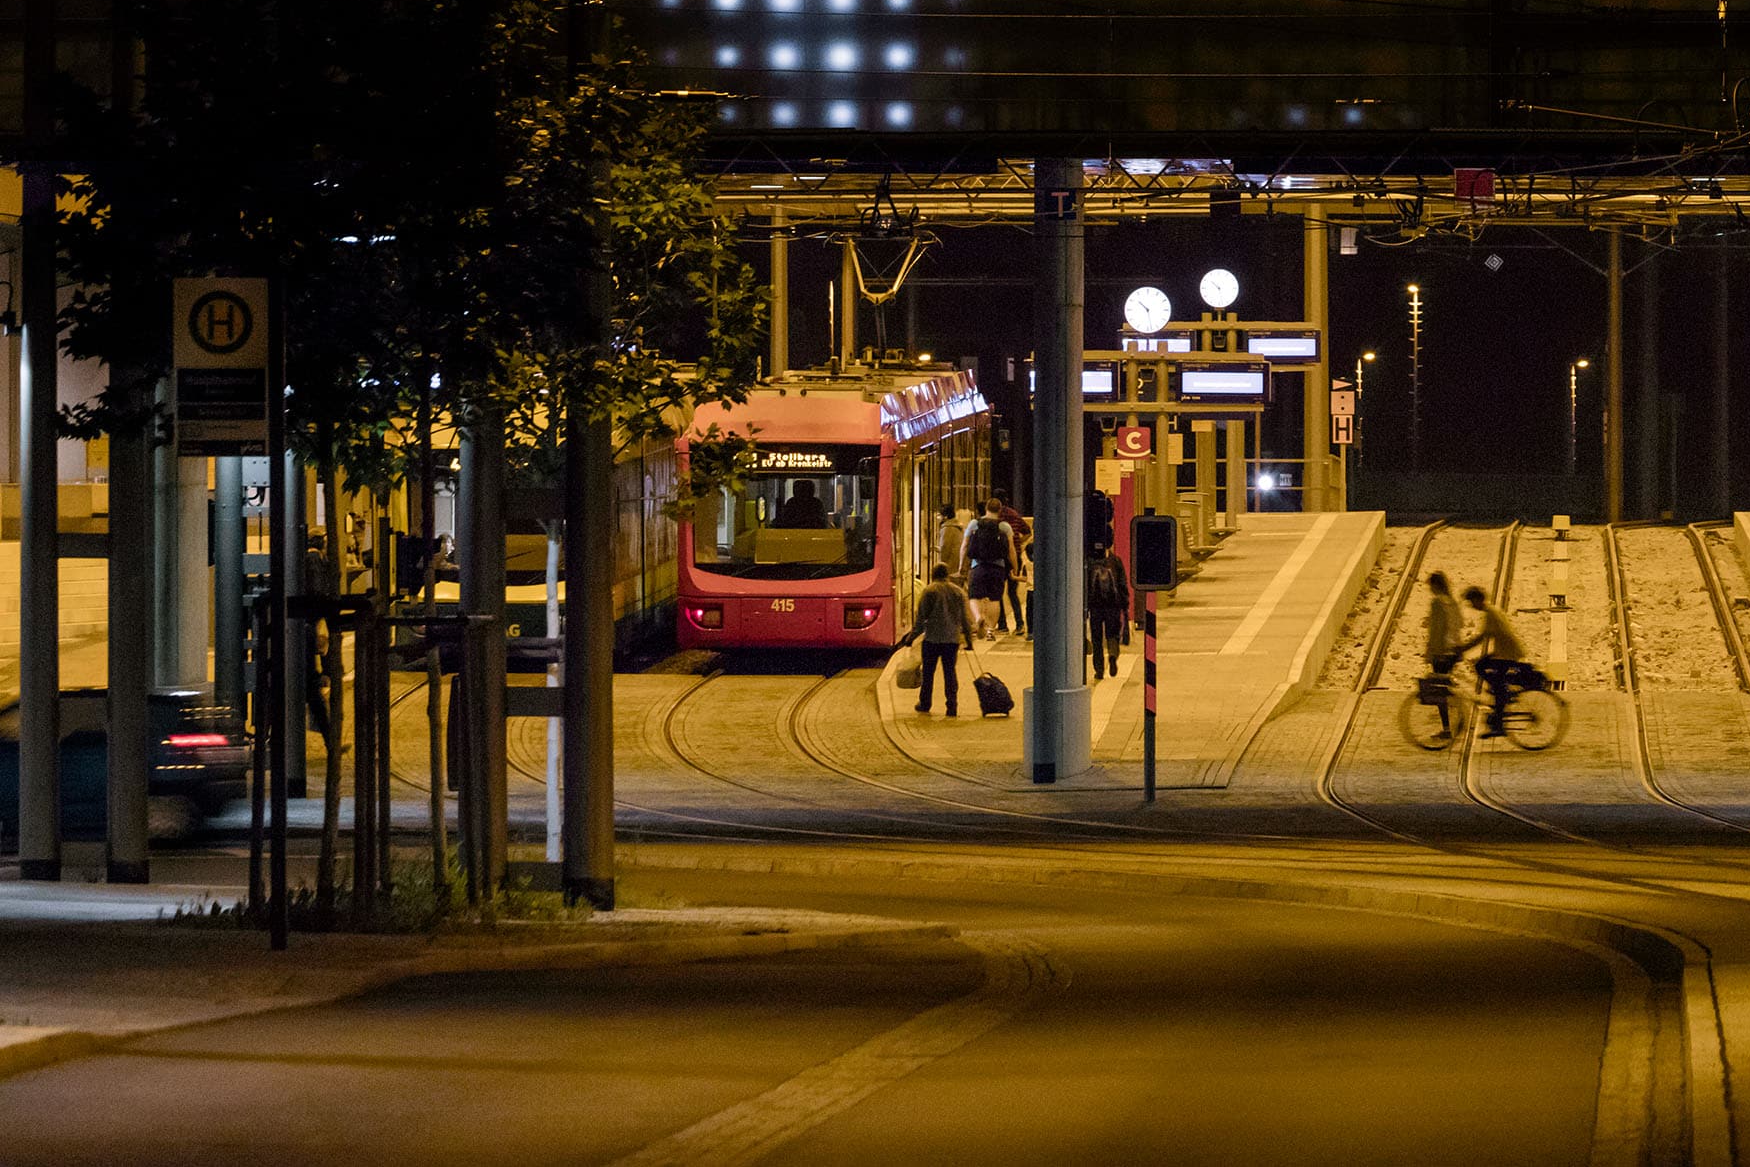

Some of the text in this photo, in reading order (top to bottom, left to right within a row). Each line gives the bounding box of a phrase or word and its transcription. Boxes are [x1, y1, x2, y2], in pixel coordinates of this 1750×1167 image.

[1051, 191, 1070, 218] T
[208, 304, 234, 341] H
[1335, 416, 1350, 442] H
[1126, 431, 1142, 450] C
[768, 452, 826, 461] Stollberg
[770, 598, 795, 612] 415
